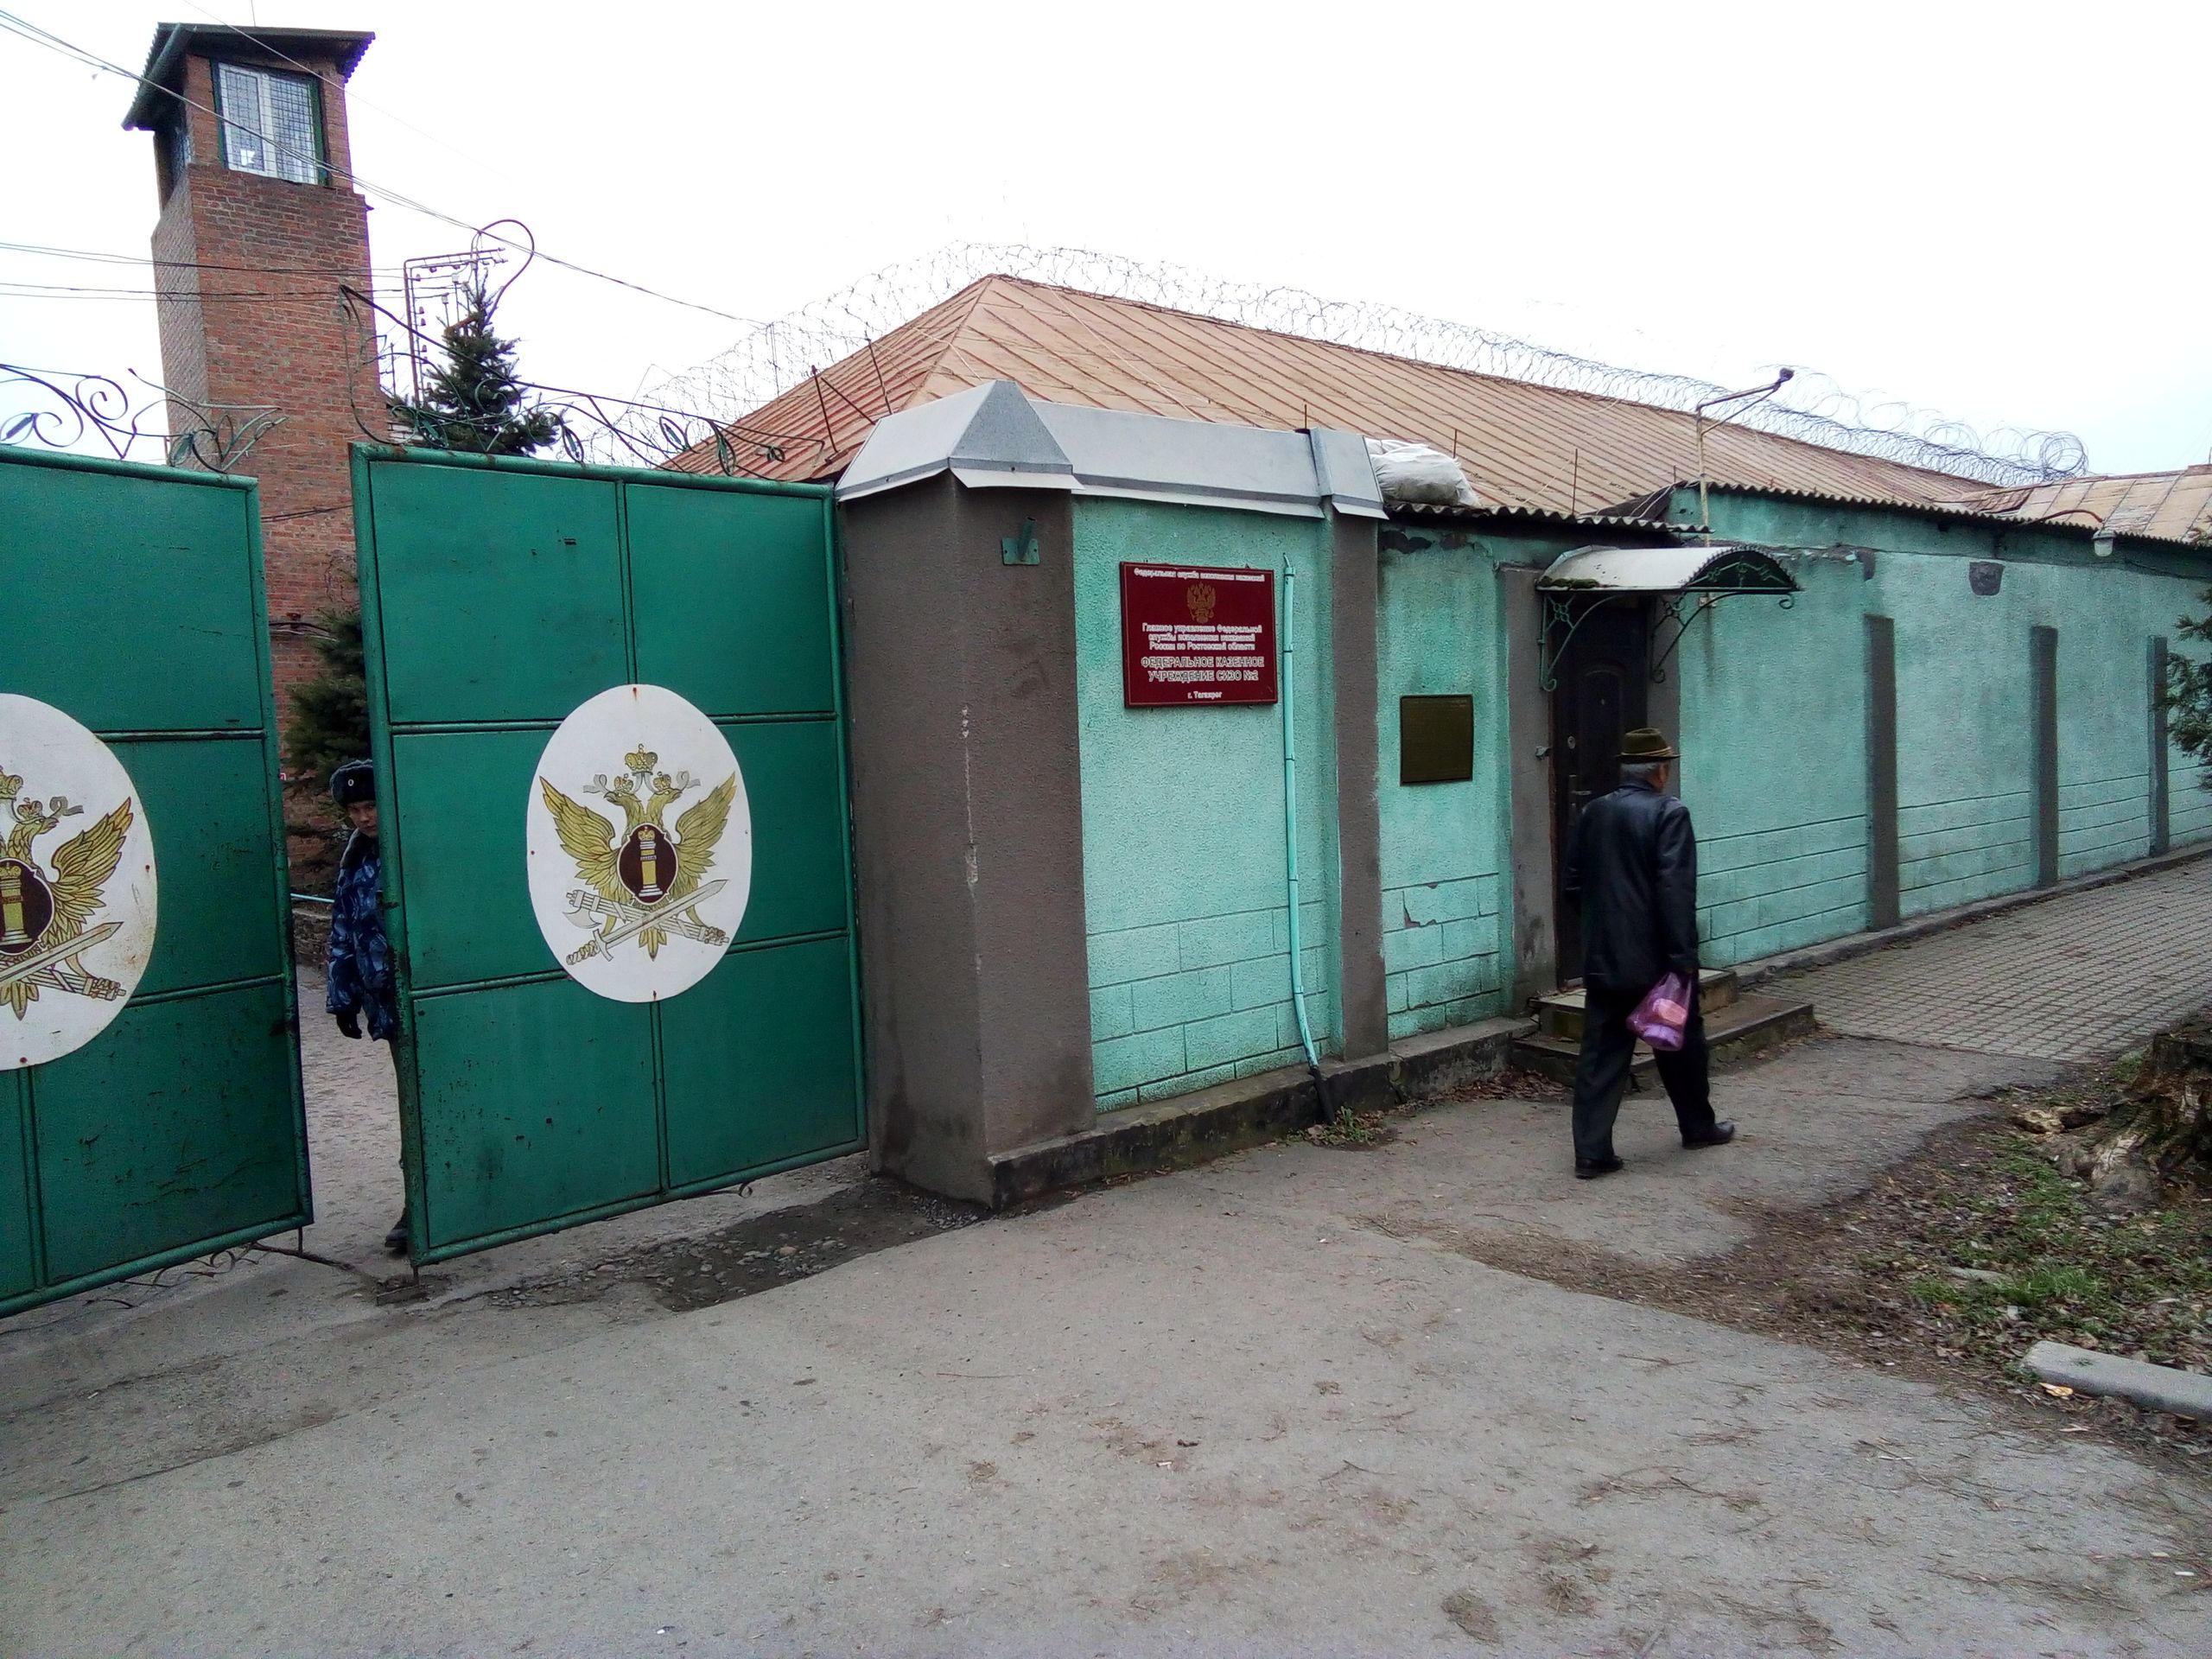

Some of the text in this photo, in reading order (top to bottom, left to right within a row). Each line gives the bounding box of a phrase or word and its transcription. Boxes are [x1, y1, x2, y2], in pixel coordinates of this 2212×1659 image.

[1141, 656, 1264, 669] ФЕДЕРАЛЬНОЕ КАЗЕННОЕ
[1147, 670, 1258, 683] УЧРЕЖДЕНИЕ СИЗО №2
